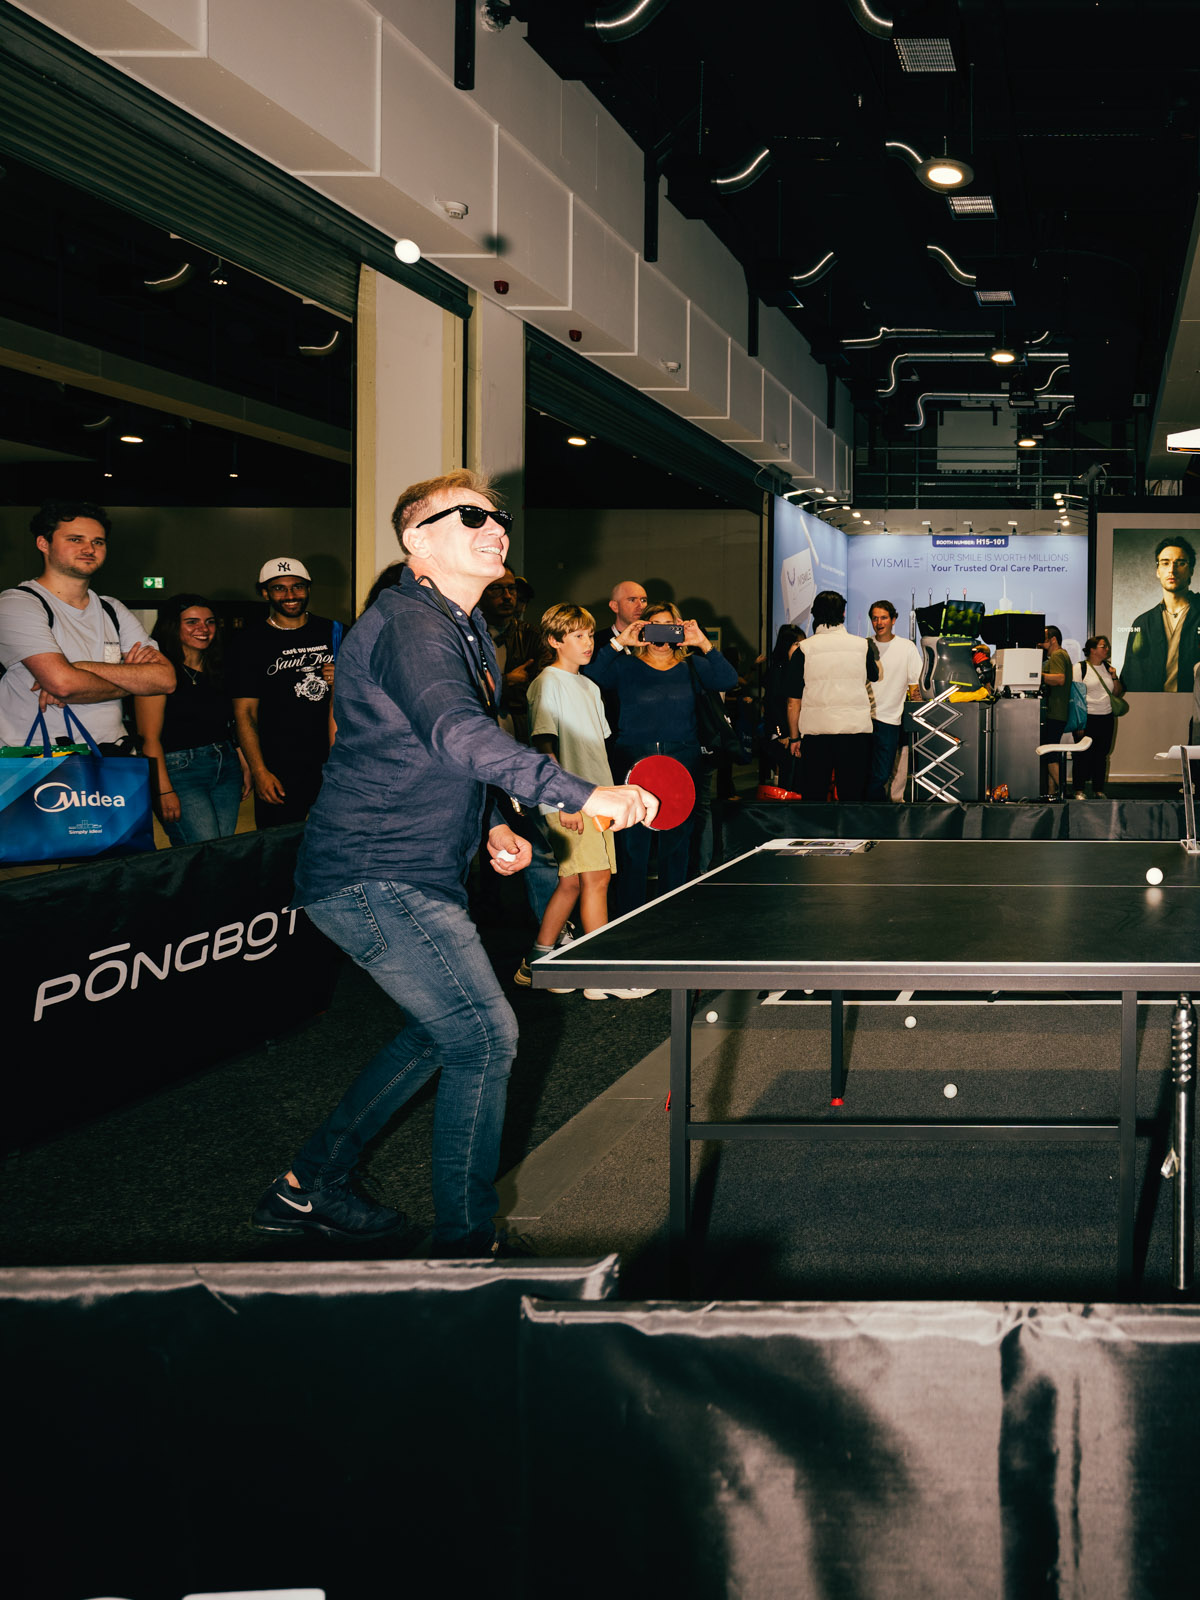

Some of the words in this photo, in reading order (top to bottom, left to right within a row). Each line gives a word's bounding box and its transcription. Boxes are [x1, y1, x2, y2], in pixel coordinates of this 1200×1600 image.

[931, 553, 955, 561] YOUR
[957, 553, 982, 561] SMILE
[984, 553, 992, 561] IS
[993, 553, 1026, 561] WORTH
[1028, 553, 1069, 561] MILLIONS
[277, 562, 291, 572] NY
[931, 564, 952, 572] Your
[954, 564, 987, 572] Trusted
[989, 564, 1008, 572] Oral
[1010, 564, 1031, 572] Care
[1033, 564, 1068, 572] Partner.
[306, 645, 329, 653] MONDE
[267, 654, 308, 676] Saint
[34, 782, 125, 813] Midea
